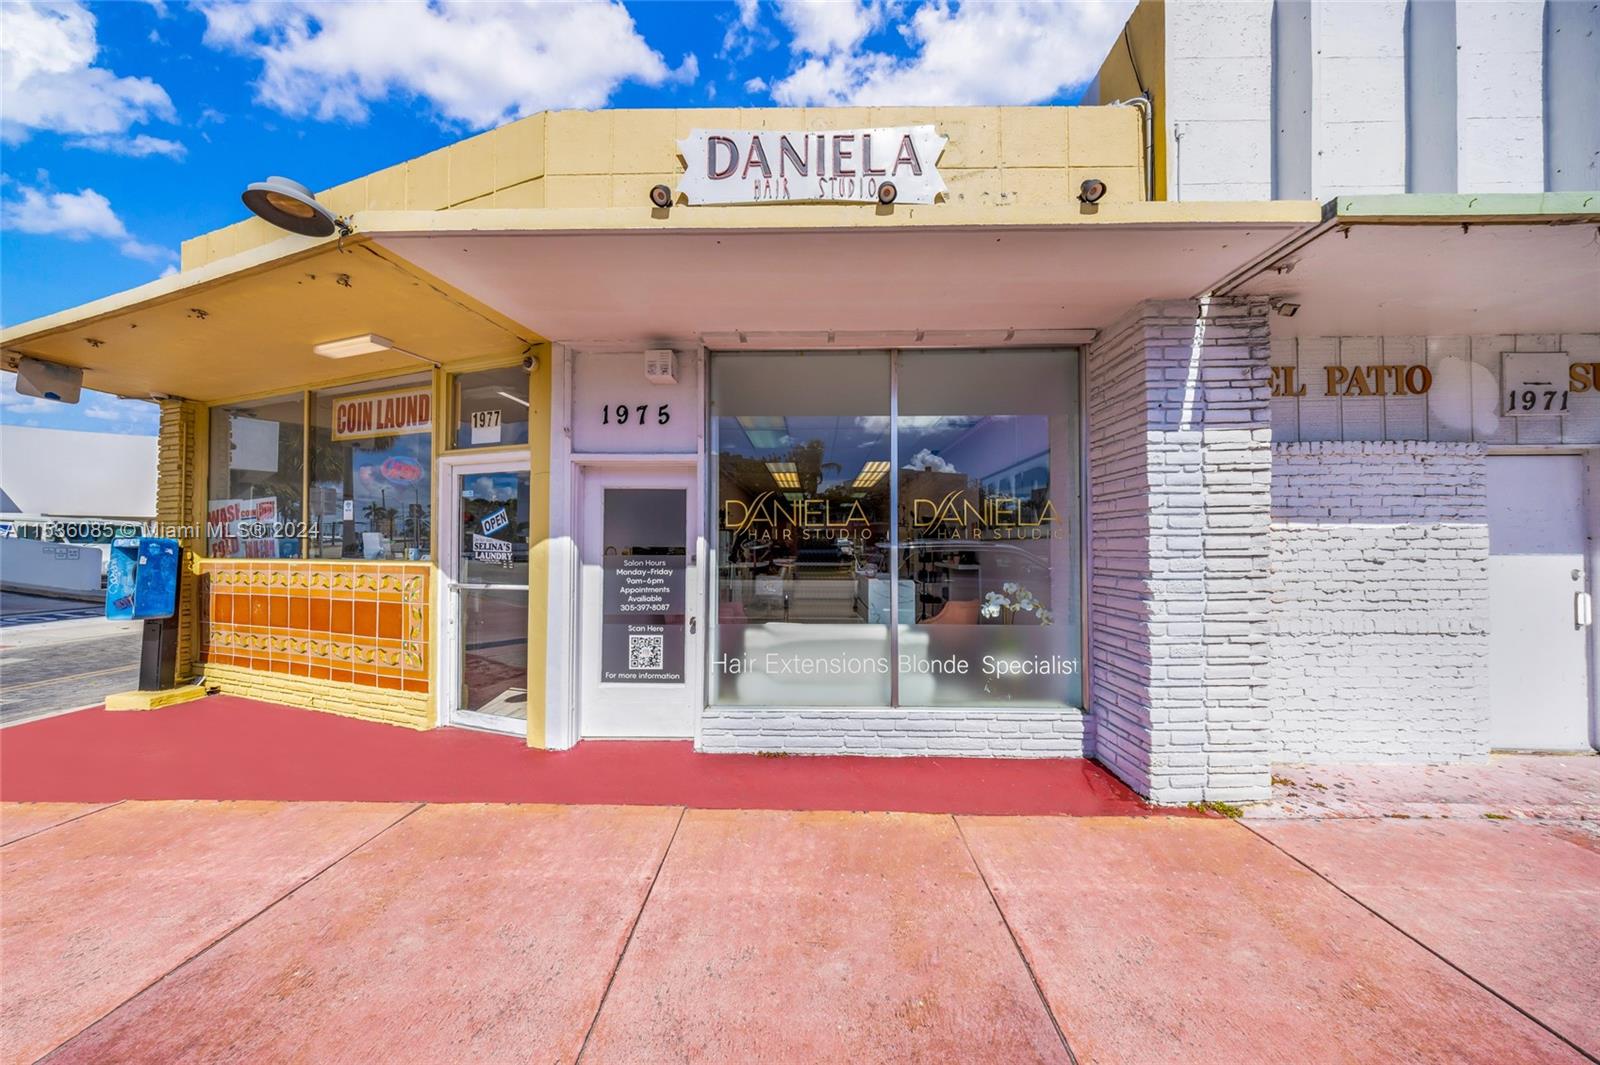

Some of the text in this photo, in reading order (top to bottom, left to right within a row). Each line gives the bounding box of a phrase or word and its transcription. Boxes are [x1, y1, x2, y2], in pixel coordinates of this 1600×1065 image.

[707, 135, 922, 179] DANIELA
[754, 177, 877, 200] HAIR STUDIO
[1324, 364, 1433, 397] PATIO
[1507, 390, 1569, 411] 1971
[337, 394, 432, 434] COIN LAUND
[472, 411, 500, 428] 1977
[602, 404, 671, 425] 1975
[484, 510, 507, 532] OPEN
[725, 493, 870, 530] DANIELA
[914, 493, 1063, 530] DANIELA
[749, 528, 872, 540] HAIR STUDIO
[937, 528, 982, 540] HAIR
[474, 542, 511, 551] SELINA'S
[475, 551, 513, 561] LAUNDRY
[645, 559, 666, 567] Hours
[620, 586, 670, 595] Appointments
[647, 624, 664, 632] Here
[711, 652, 889, 674] Hair Extensions
[898, 654, 1079, 678] Blonde Specialist
[638, 671, 680, 680] information
